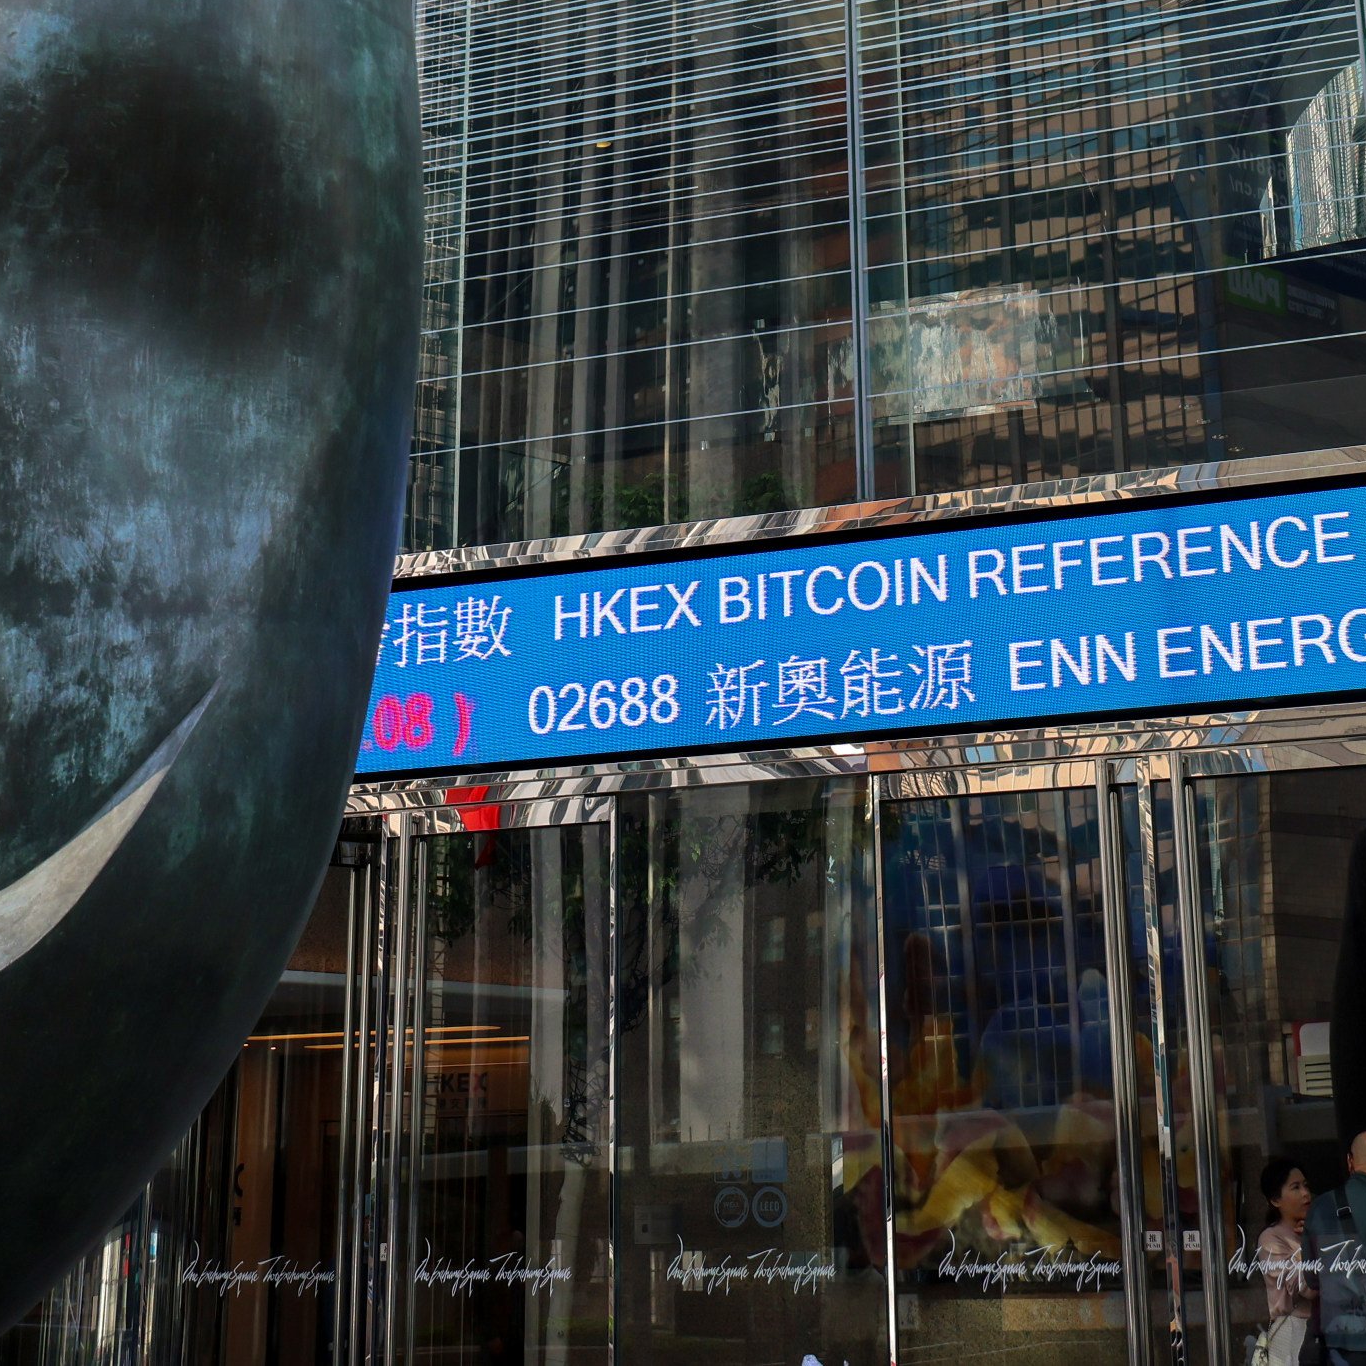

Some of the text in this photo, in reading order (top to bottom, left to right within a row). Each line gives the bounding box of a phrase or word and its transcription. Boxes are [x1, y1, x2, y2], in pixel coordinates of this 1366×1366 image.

[376, 595, 513, 667] 指數
[554, 580, 702, 641] HKEX
[719, 554, 948, 624] BITCOIN
[968, 511, 1355, 598] REFERENCE
[528, 674, 680, 734] 02688
[706, 640, 976, 730] 新奧能源
[1008, 632, 1136, 691] ENN
[760, 1202, 780, 1211] LEED
